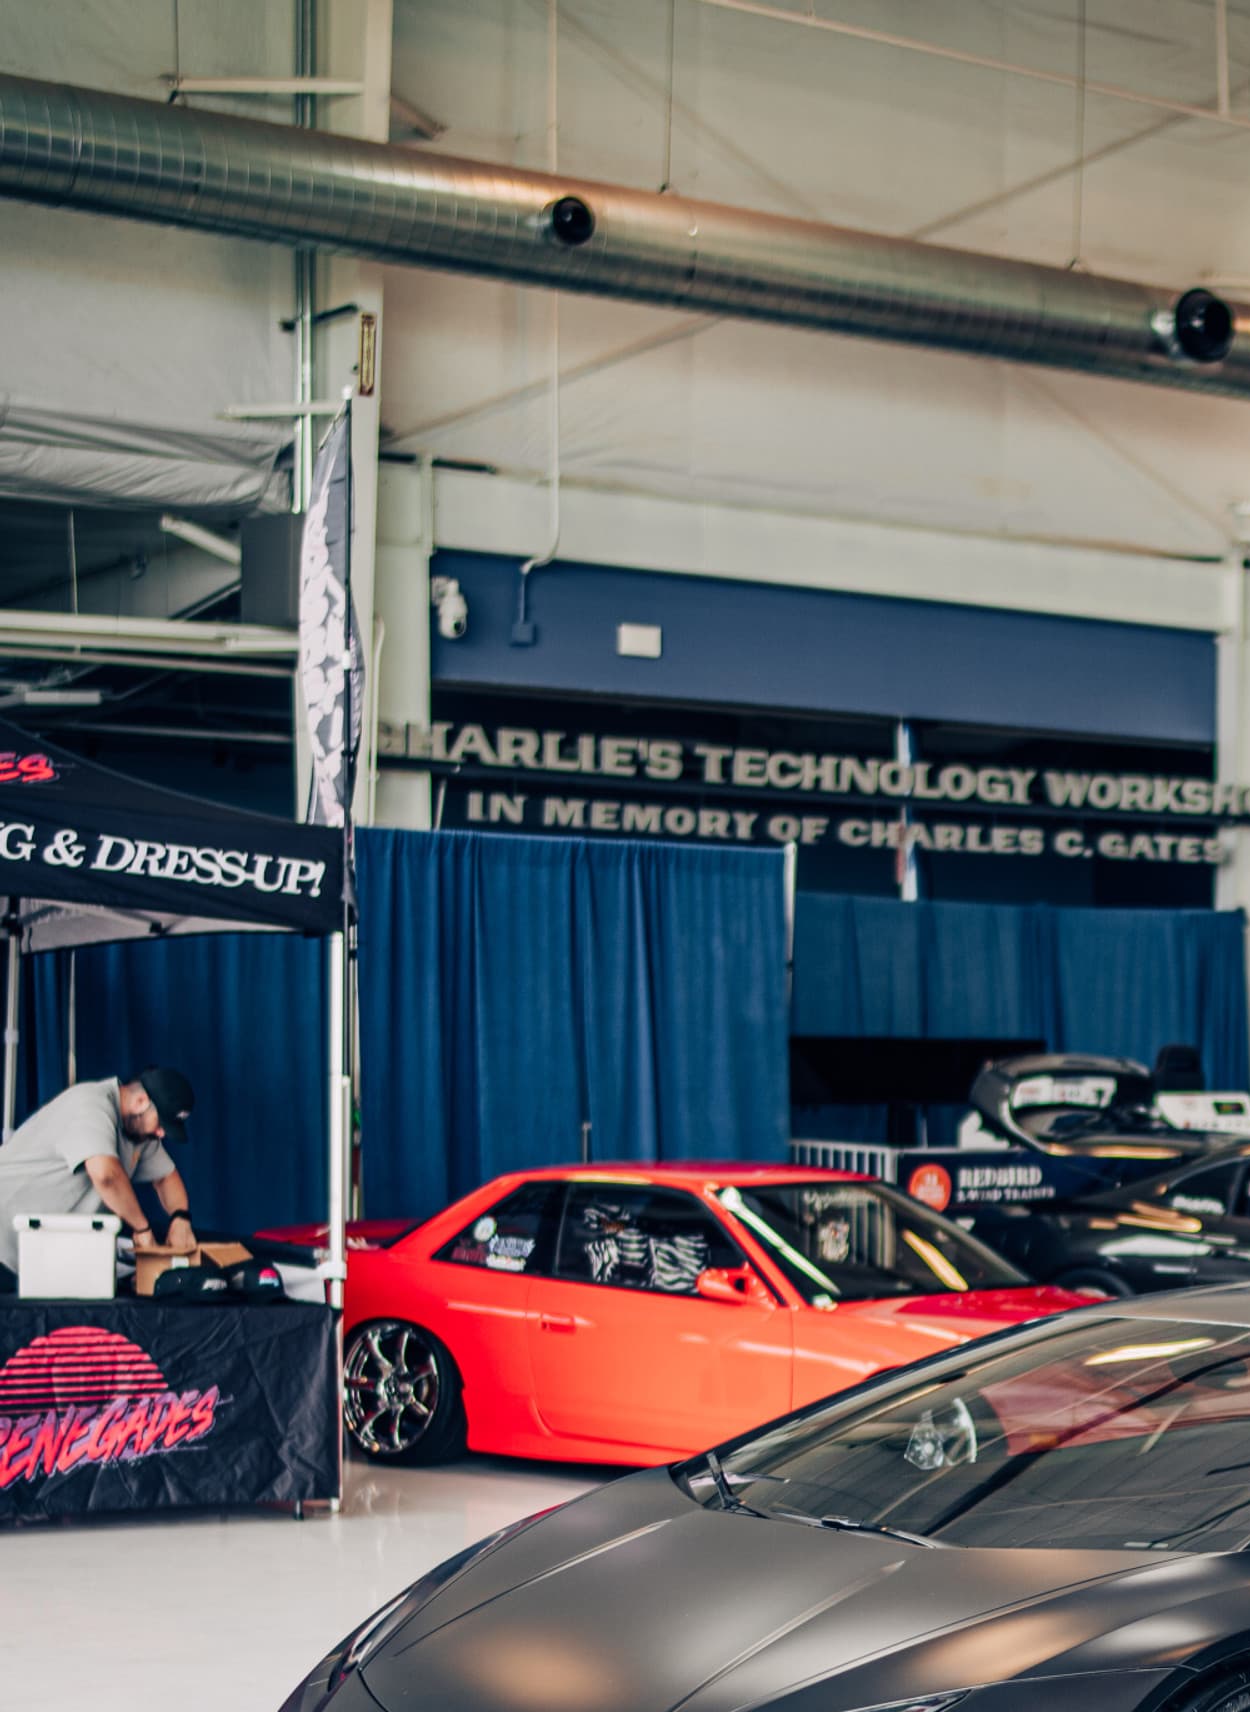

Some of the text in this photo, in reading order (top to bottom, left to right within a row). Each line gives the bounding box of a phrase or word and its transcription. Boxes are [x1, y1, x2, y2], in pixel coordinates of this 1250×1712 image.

[0, 751, 56, 783] ES
[694, 744, 1036, 805] TECHNOLOGY
[467, 792, 526, 824] IN
[543, 796, 758, 840] MEMORY
[768, 814, 829, 845] OF
[838, 819, 1044, 855] CHARLES
[1098, 833, 1229, 865] GATES
[0, 822, 325, 898] G & DRESS-UP!
[958, 1167, 1042, 1189] REDBIRD
